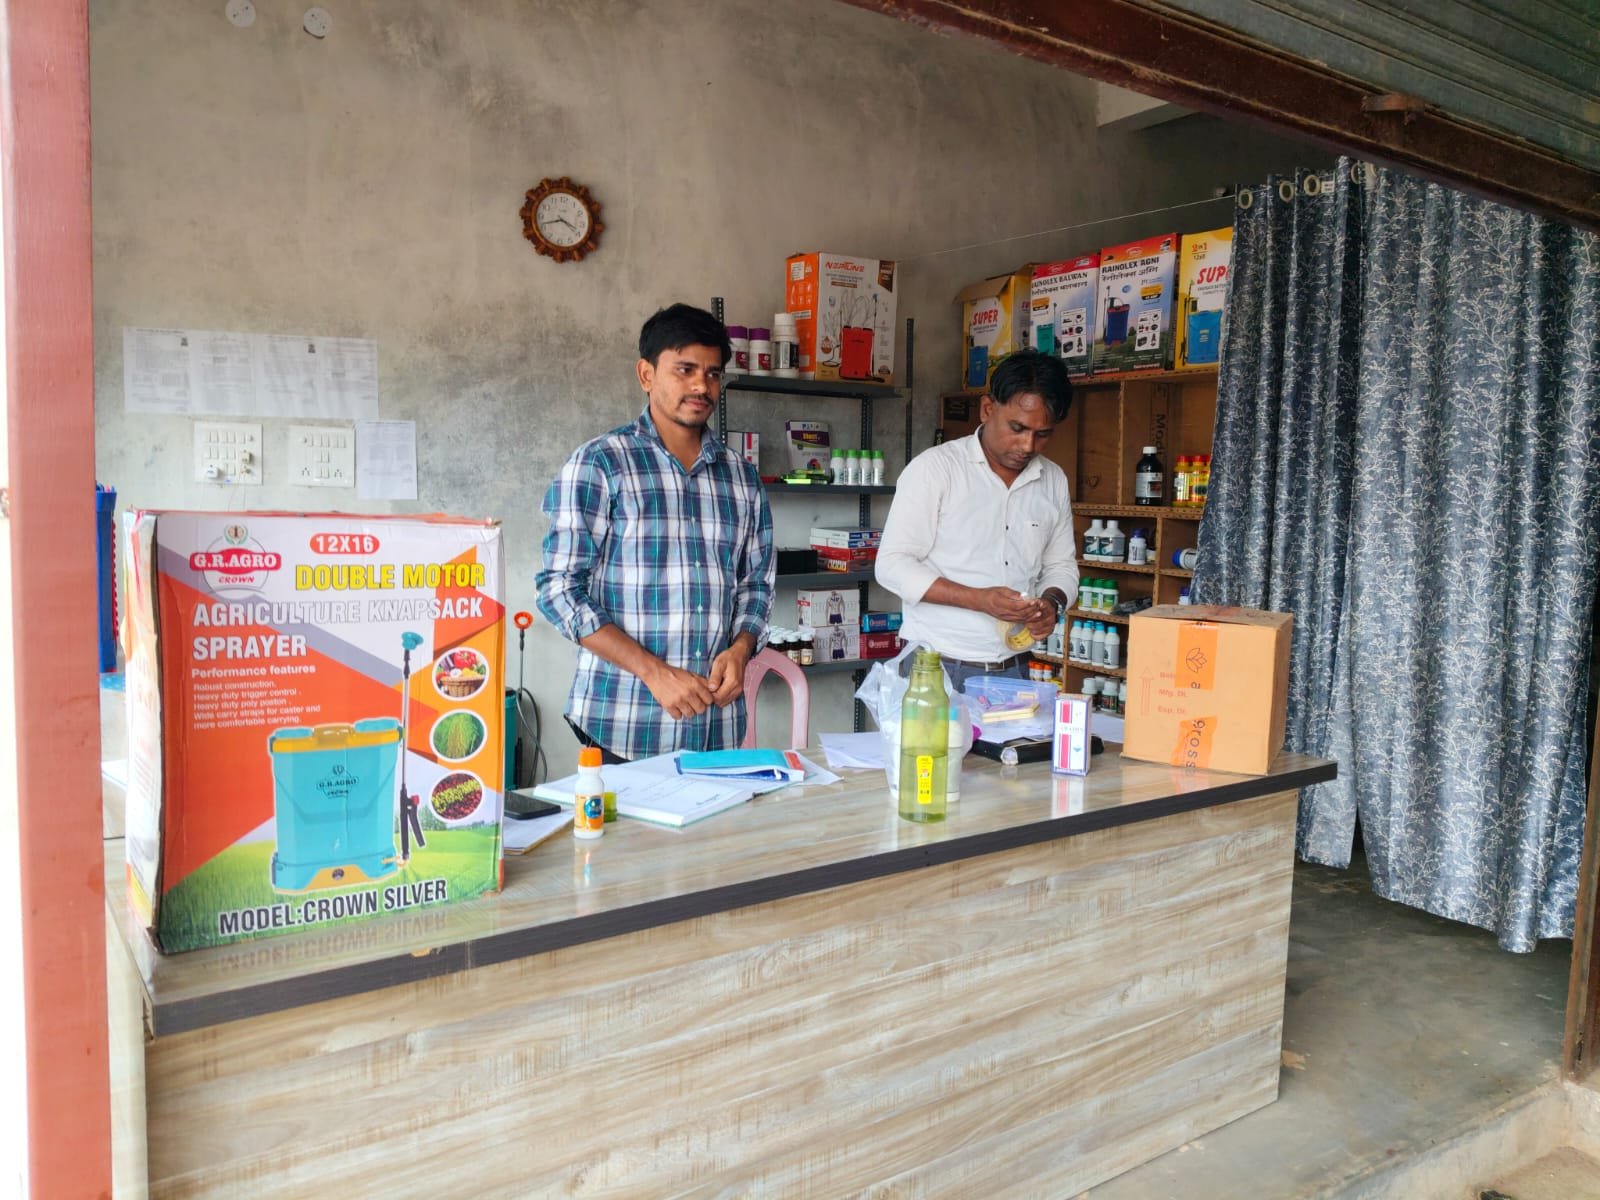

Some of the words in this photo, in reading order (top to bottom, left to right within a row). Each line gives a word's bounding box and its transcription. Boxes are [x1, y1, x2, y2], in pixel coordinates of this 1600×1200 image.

[1101, 260, 1138, 273] RAINOLEX
[1140, 256, 1160, 266] AGNI
[1059, 272, 1088, 283] BALWAN
[973, 309, 998, 325] SUPER
[315, 535, 374, 553] 12X16
[194, 553, 277, 569] G.R.AGRO
[218, 575, 255, 584] CROWN
[296, 564, 395, 591] DOUBLE
[402, 563, 485, 588] MOTOR
[193, 600, 361, 627] AGRICULTURE
[367, 597, 483, 623] KNAPSACK
[192, 634, 307, 661] SPRAYER
[191, 667, 267, 678] Performance
[270, 665, 316, 674] features
[384, 880, 447, 910] SILVER
